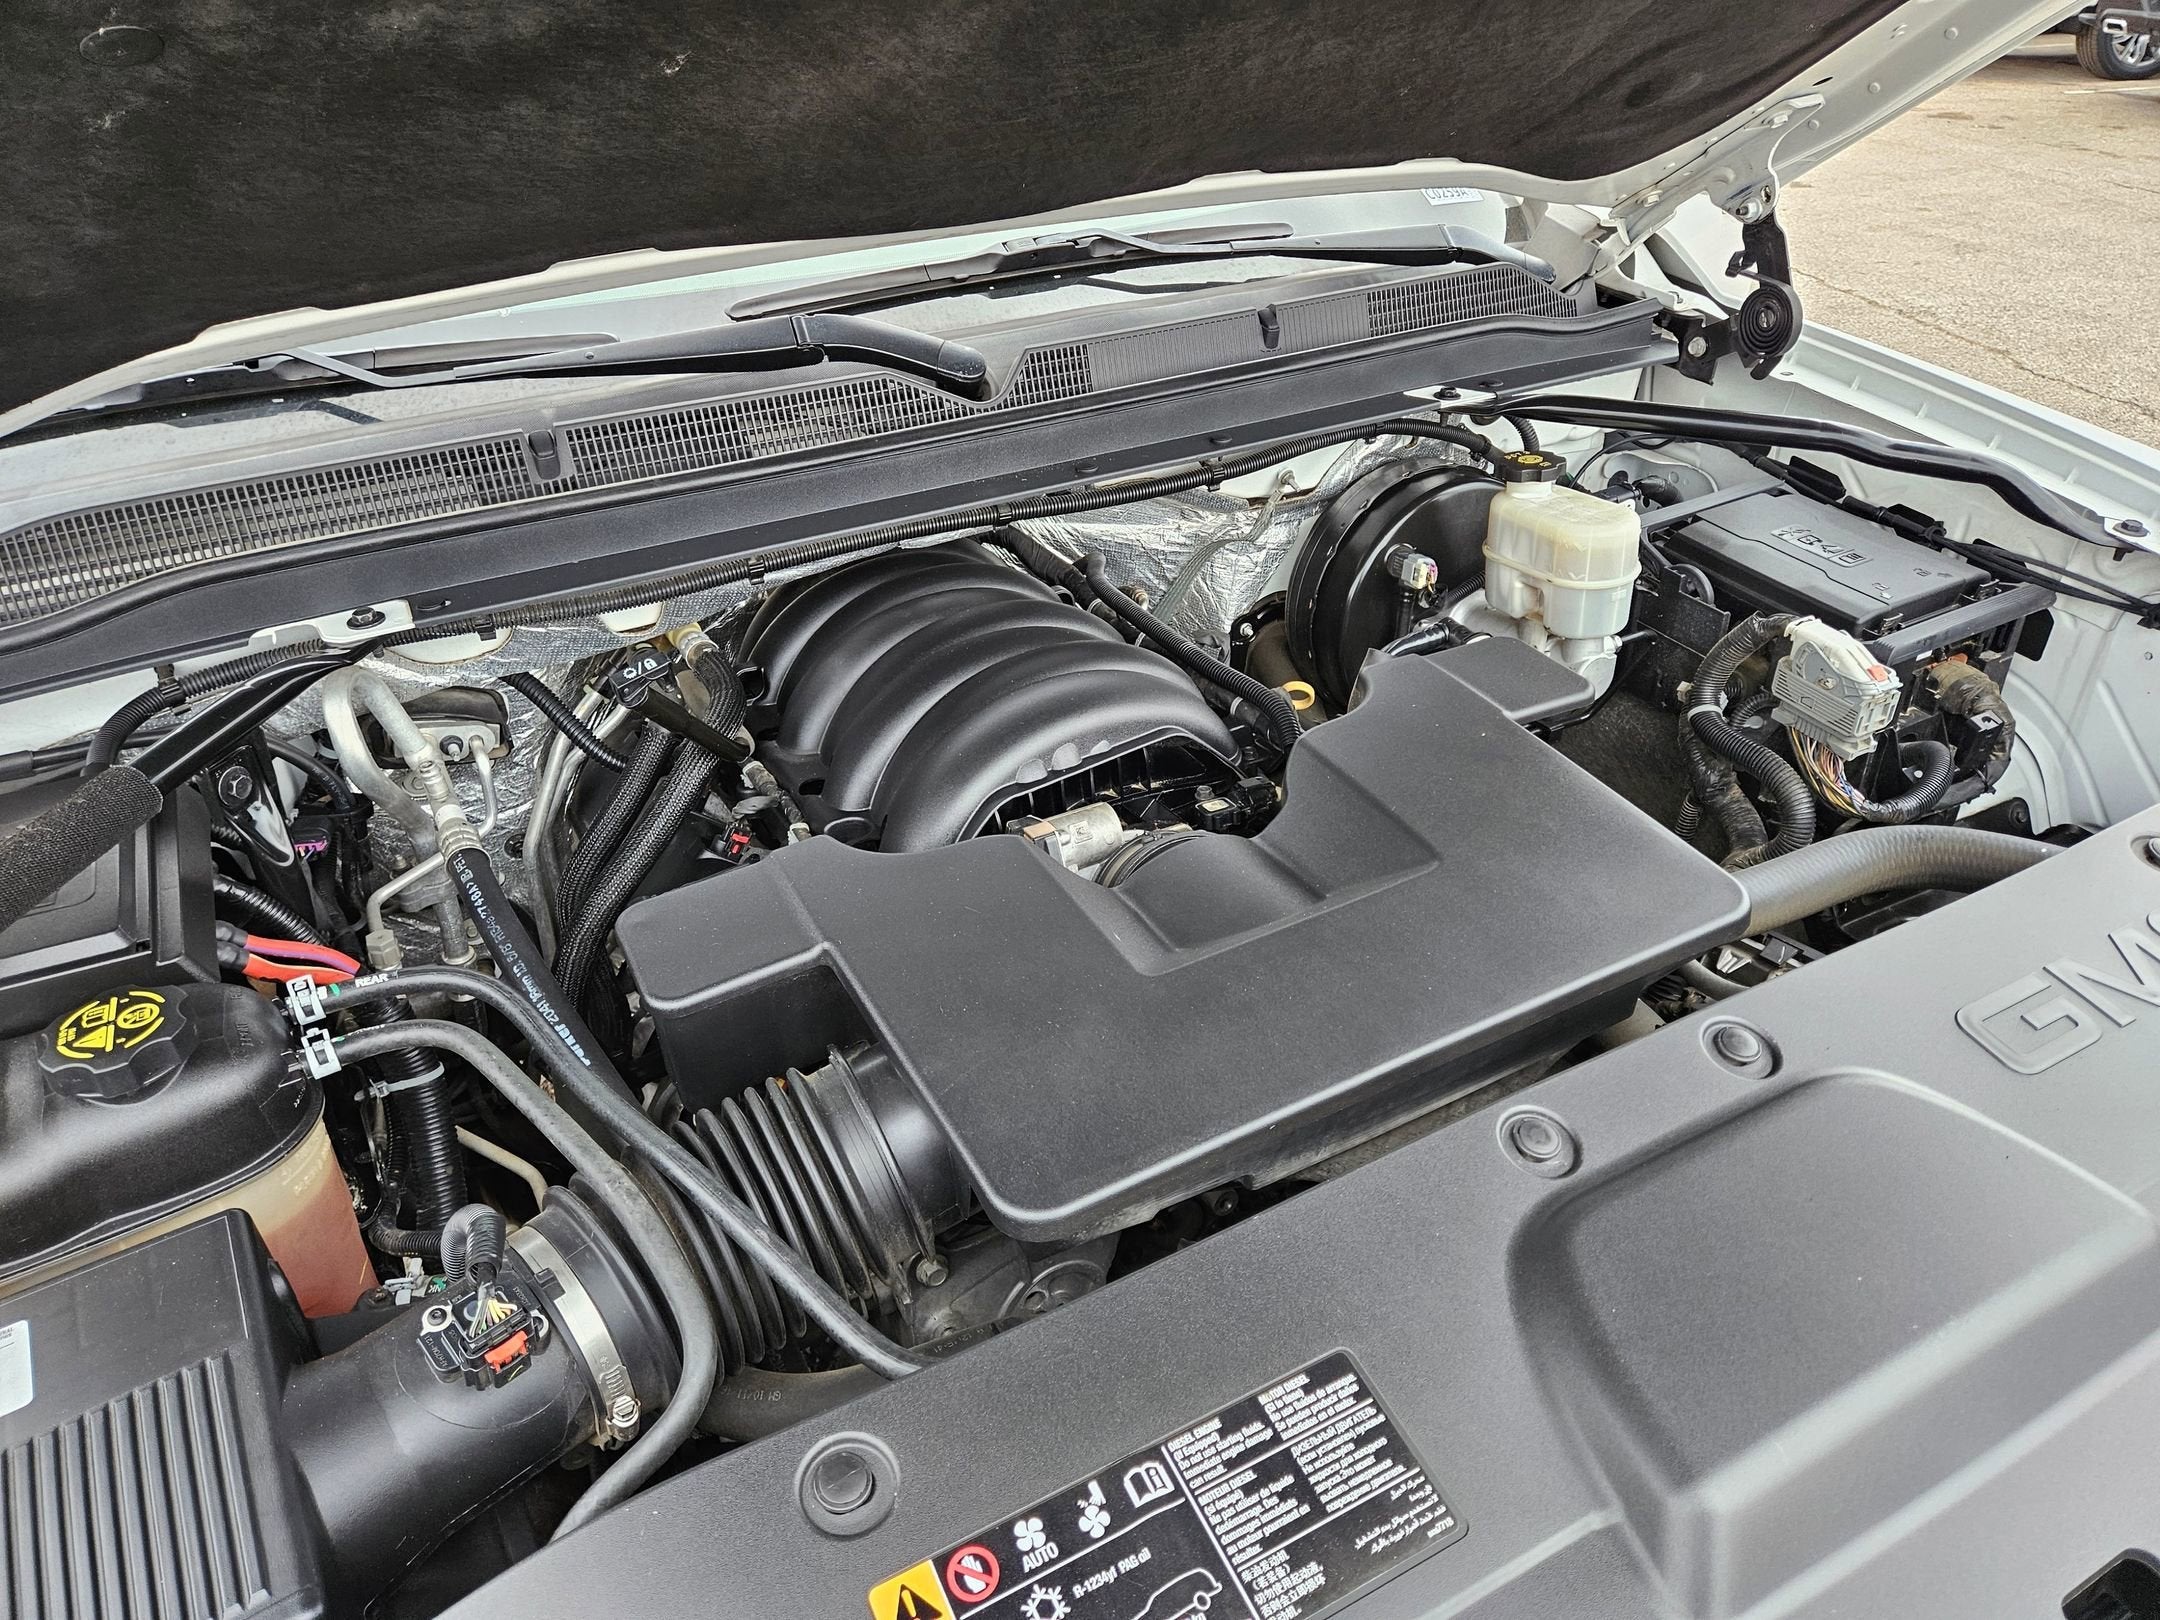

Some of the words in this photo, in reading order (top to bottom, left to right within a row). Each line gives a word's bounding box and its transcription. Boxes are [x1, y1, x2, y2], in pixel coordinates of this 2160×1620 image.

[355, 973, 388, 988] REAR
[1954, 907, 2160, 1075] GM
[1258, 1386, 1286, 1405] MOTOR
[1284, 1374, 1310, 1393] DIESEL
[1168, 1433, 1195, 1452] DIESEL
[1194, 1418, 1222, 1439] ENGINE
[1292, 1427, 1337, 1458] ДИЗЕЛЬНЫЙ
[1336, 1407, 1377, 1434] ДВИГАТЕЛЬ
[1178, 1460, 1191, 1471] Do
[1190, 1452, 1204, 1465] not
[1203, 1446, 1217, 1459] use
[1216, 1433, 1244, 1451] starting
[1184, 1456, 1222, 1480] Immediate
[1222, 1443, 1246, 1461] engine
[1245, 1428, 1273, 1448] damage
[1190, 1477, 1205, 1489] can
[1199, 1483, 1231, 1506] MOTEUR
[1229, 1471, 1257, 1490] DIESEL
[1209, 1515, 1222, 1526] Ne
[1221, 1507, 1237, 1522] pas
[1260, 1488, 1271, 1499] de
[1022, 1541, 1058, 1573] AUTO
[1072, 1565, 1118, 1599] R-1234yf
[1117, 1553, 1140, 1575] PAG
[1137, 1546, 1151, 1565] oil
